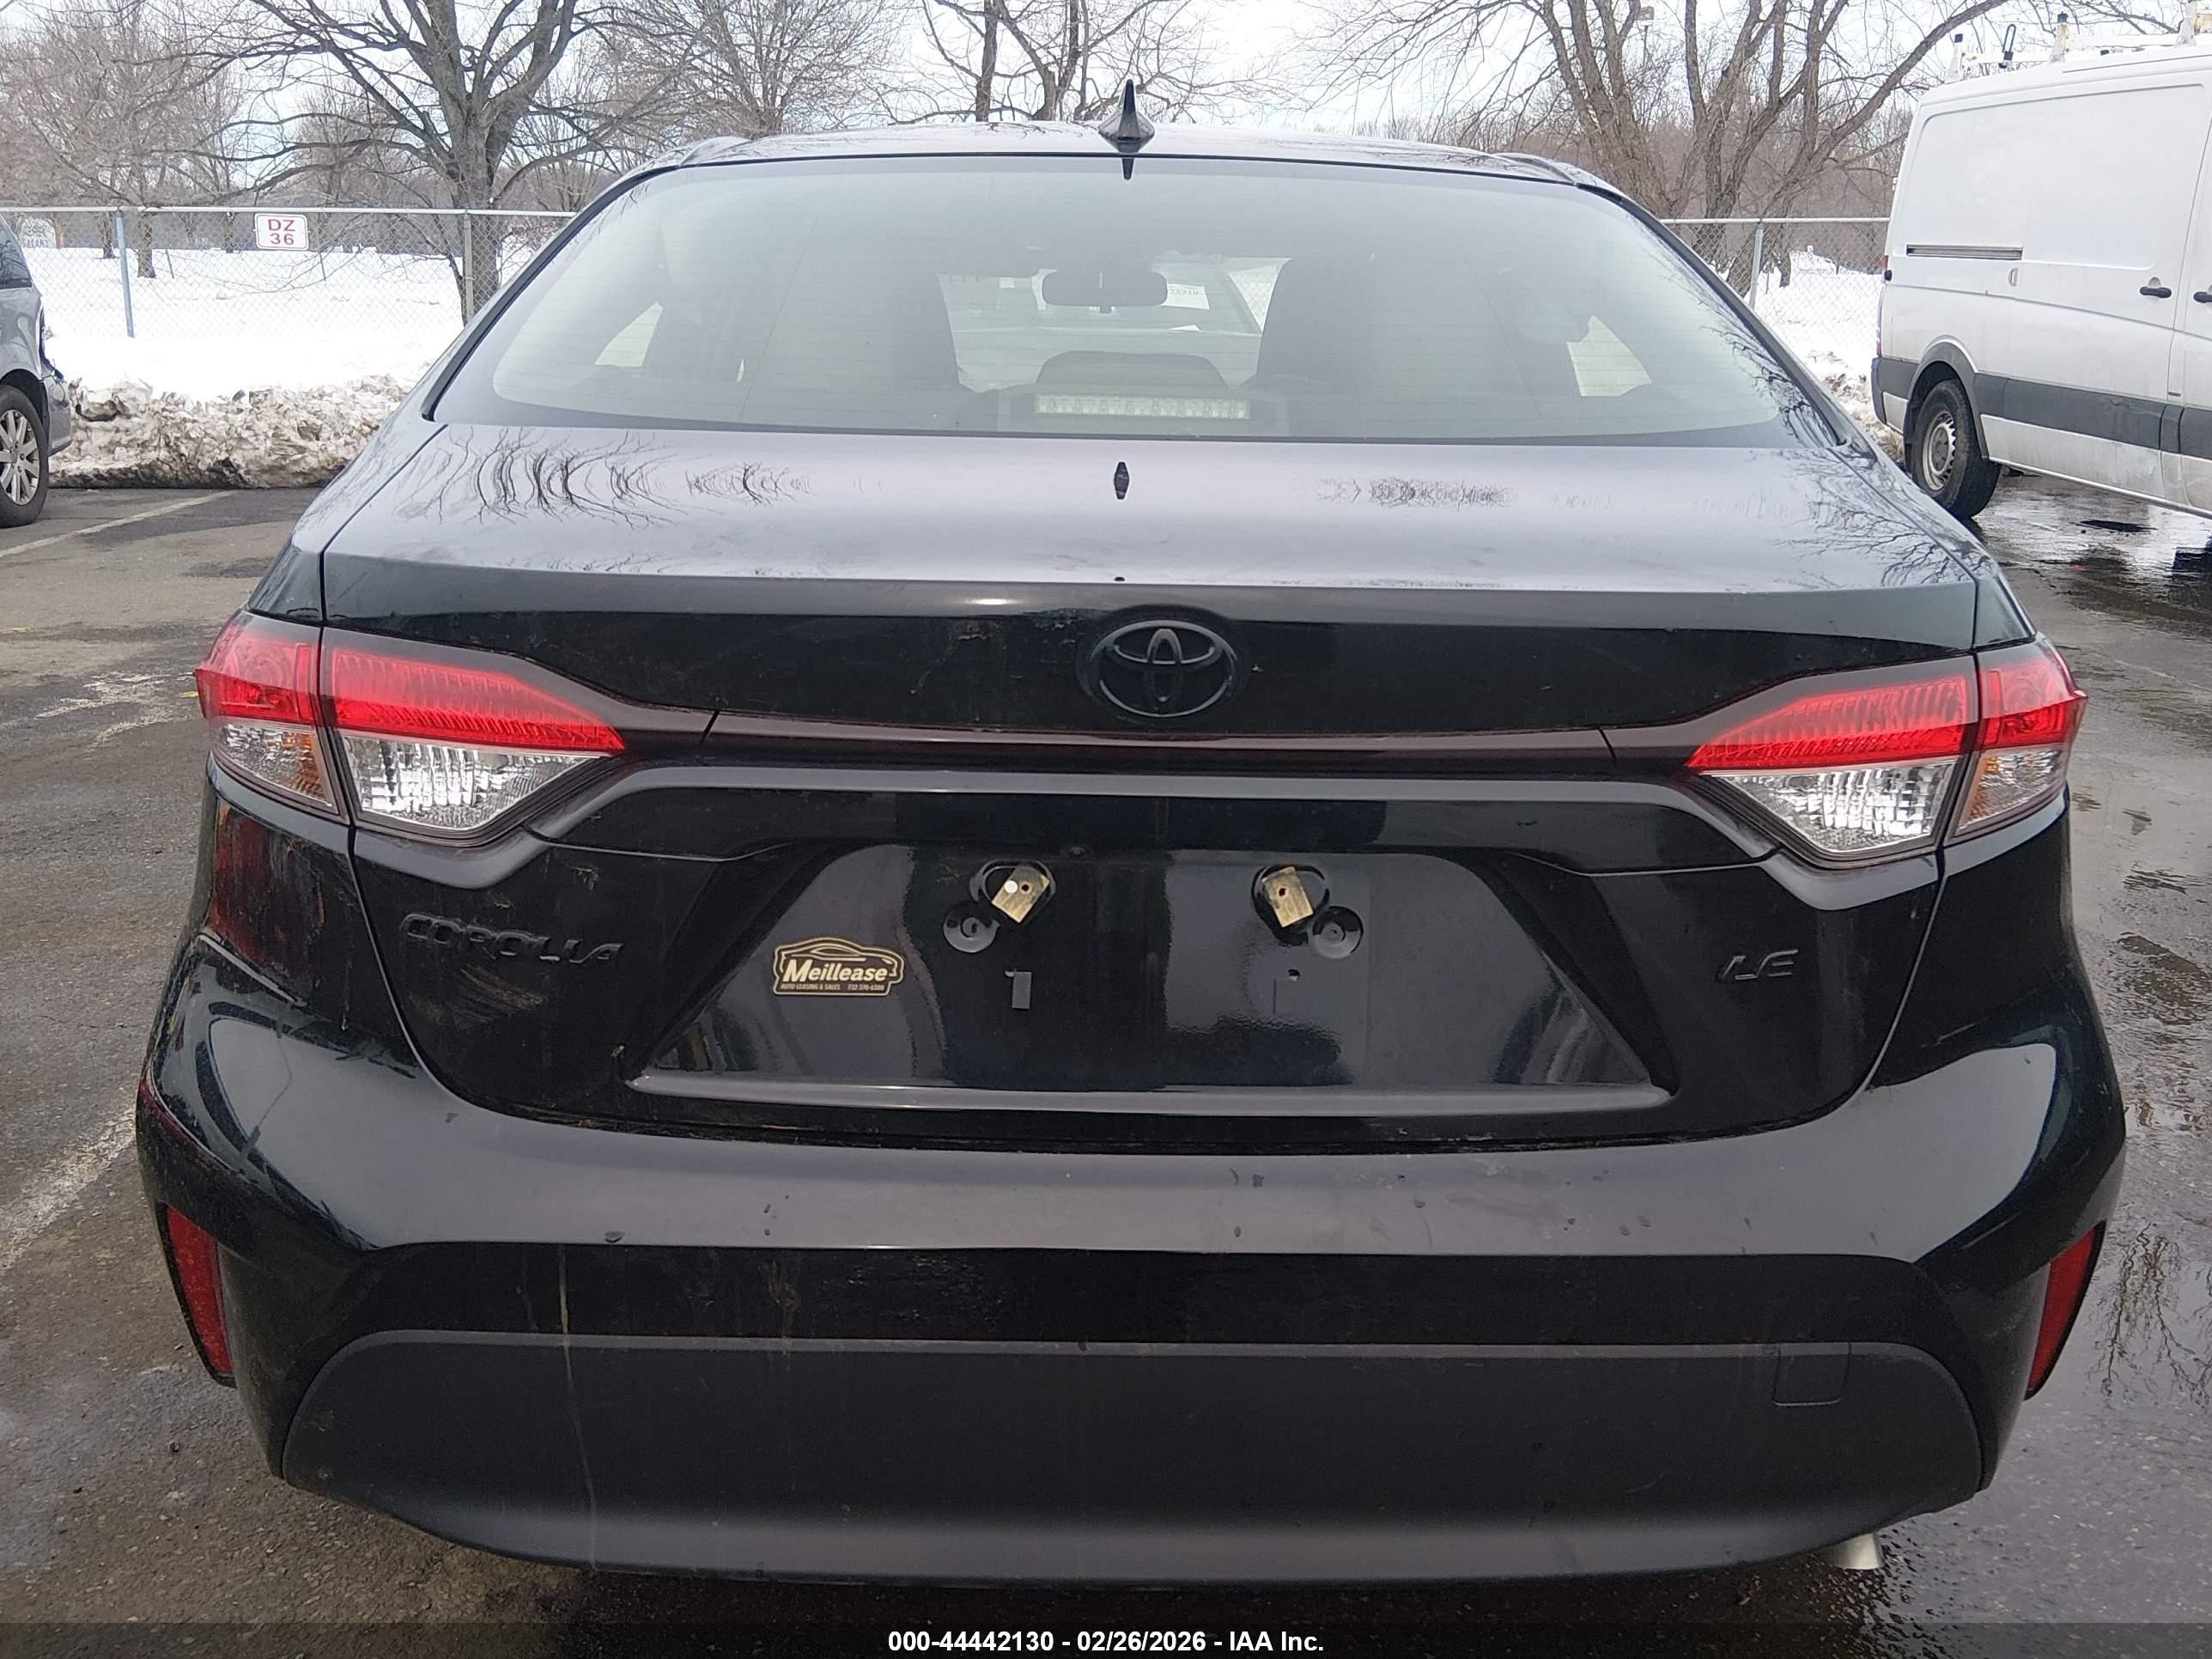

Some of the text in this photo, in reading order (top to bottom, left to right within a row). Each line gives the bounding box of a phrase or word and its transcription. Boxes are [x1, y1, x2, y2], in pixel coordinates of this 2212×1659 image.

[267, 218, 296, 232] DZ
[270, 233, 295, 246] 36
[399, 913, 623, 963] COROLLA
[782, 958, 888, 982] Meillease
[1722, 949, 1799, 980] LE
